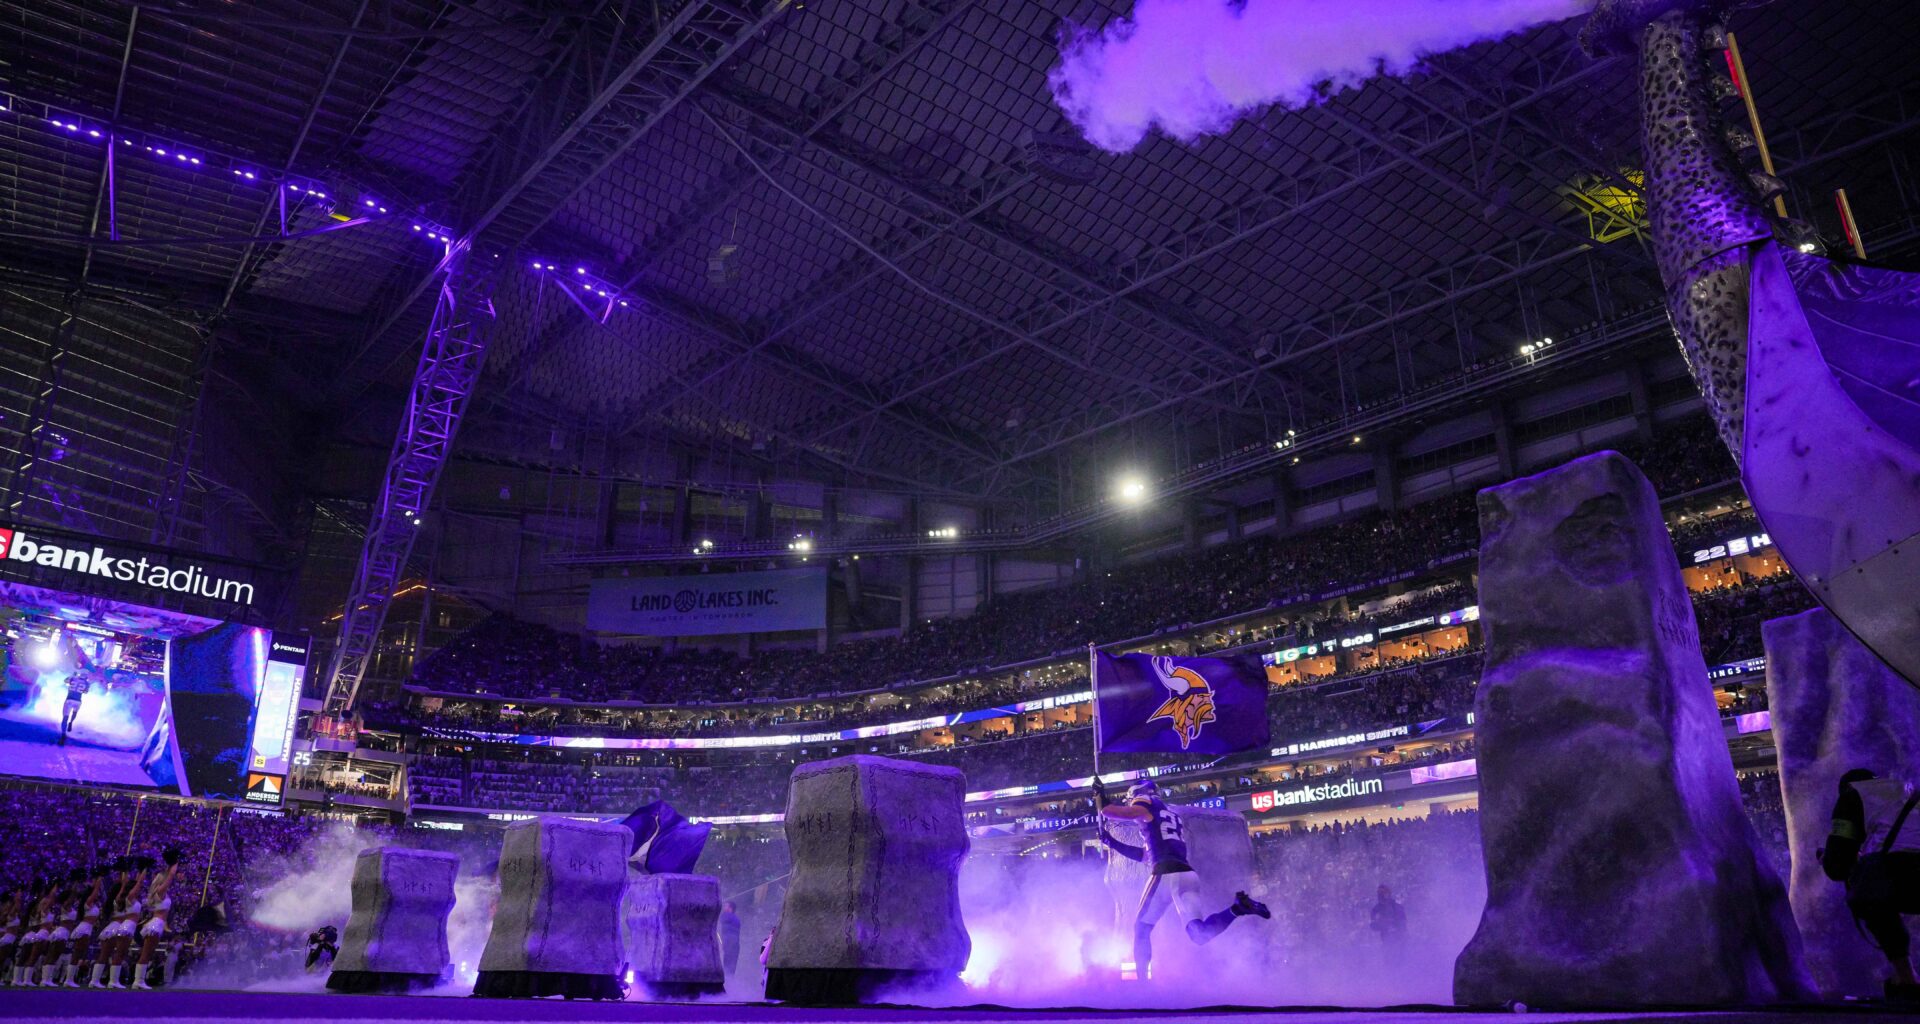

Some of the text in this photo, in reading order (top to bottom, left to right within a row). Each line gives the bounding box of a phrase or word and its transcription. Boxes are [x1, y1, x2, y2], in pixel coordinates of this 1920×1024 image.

[1693, 545, 1727, 563] 22
[631, 594, 671, 611] LAND
[1440, 615, 1451, 625] 0
[1307, 646, 1318, 655] 0
[1025, 700, 1043, 711] 22
[1271, 725, 1408, 757] 22 HARRISON SMITH
[293, 752, 311, 766] 25
[246, 791, 280, 800] ANDERSEN
[1160, 809, 1185, 843] 2
